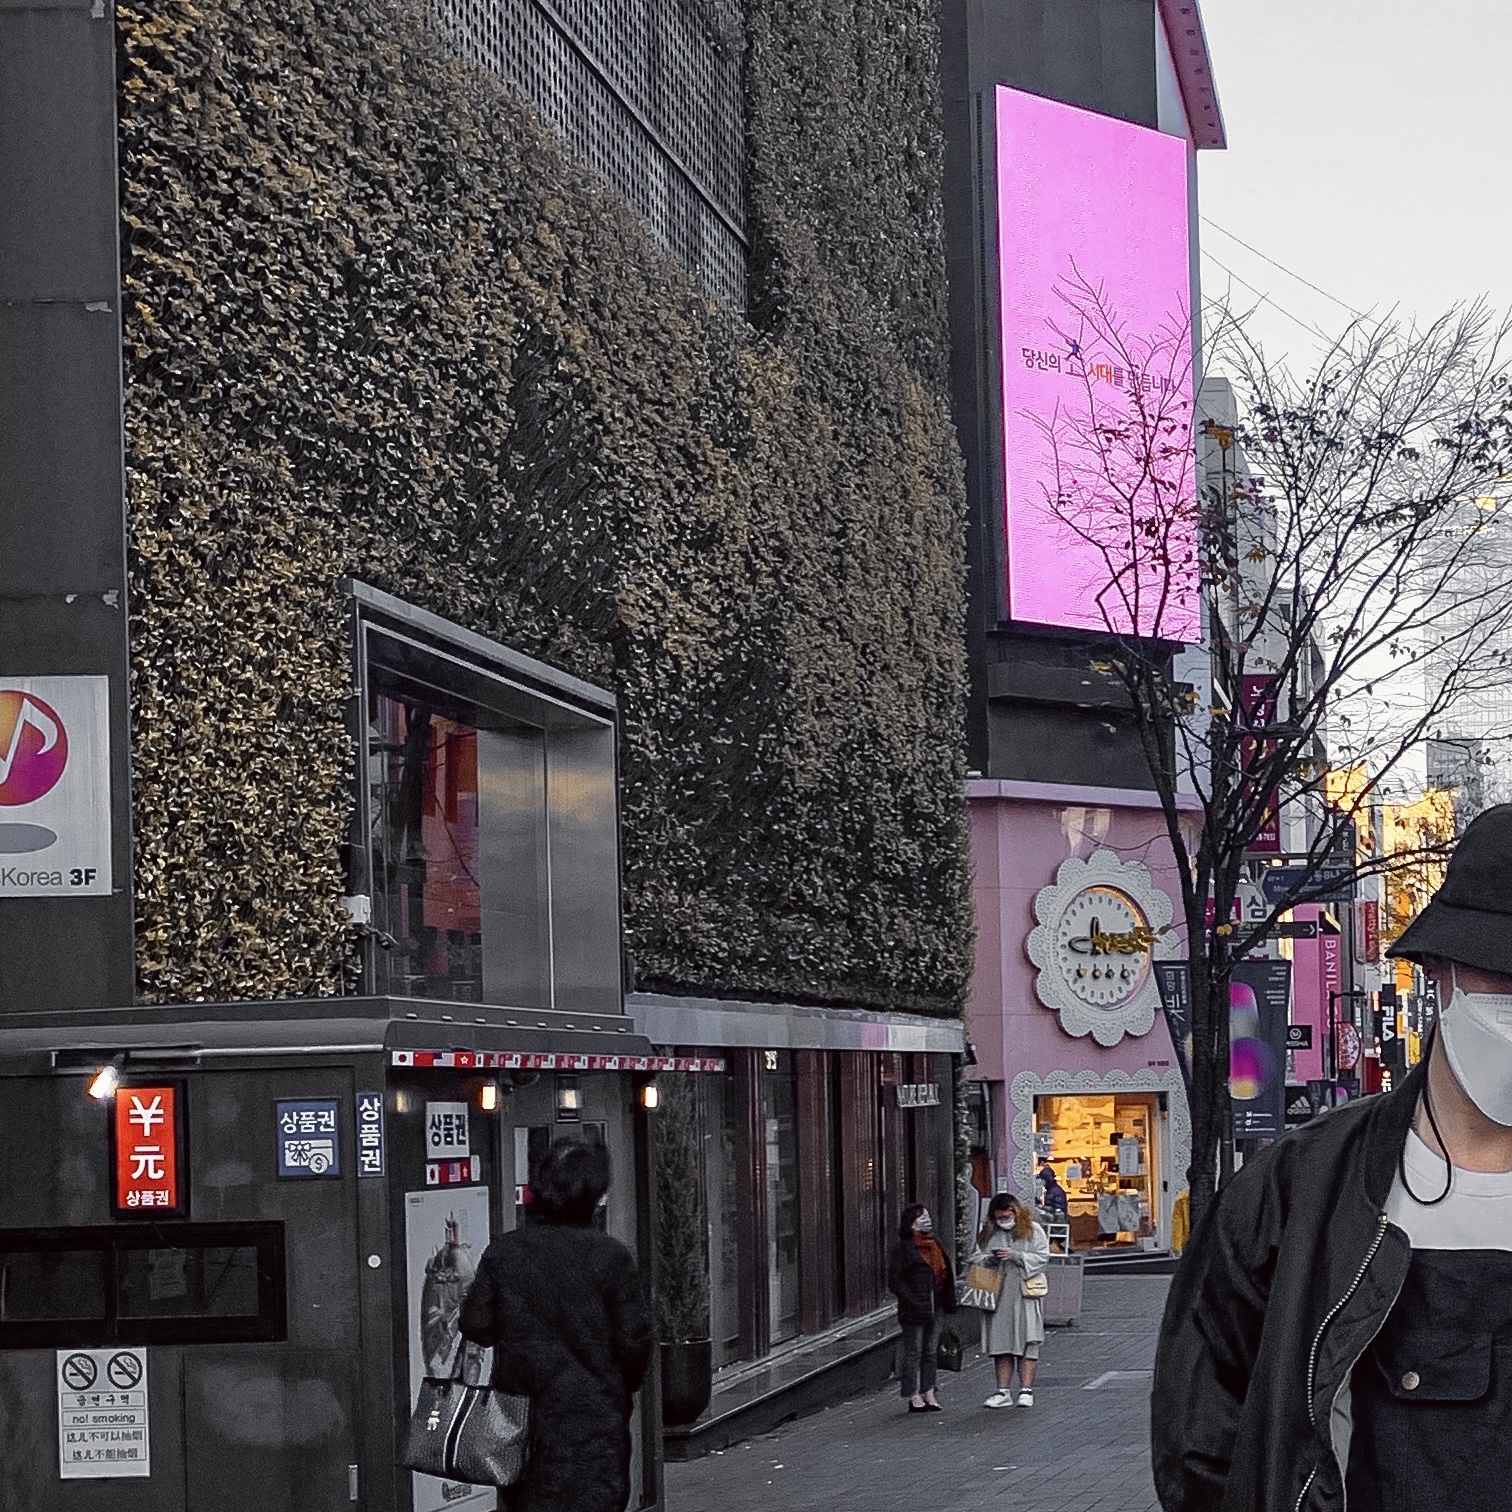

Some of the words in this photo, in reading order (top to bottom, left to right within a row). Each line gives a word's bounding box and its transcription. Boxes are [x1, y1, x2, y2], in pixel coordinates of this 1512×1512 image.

[1021, 348, 1061, 373] 당신의
[70, 868, 97, 886] 3F
[1381, 1005, 1395, 1041] FILA
[280, 1110, 335, 1133] 상품권
[429, 1114, 466, 1146] 상품권
[360, 1098, 381, 1171] 상품권
[126, 1190, 169, 1206] 상품권
[92, 1413, 136, 1424] smoking
